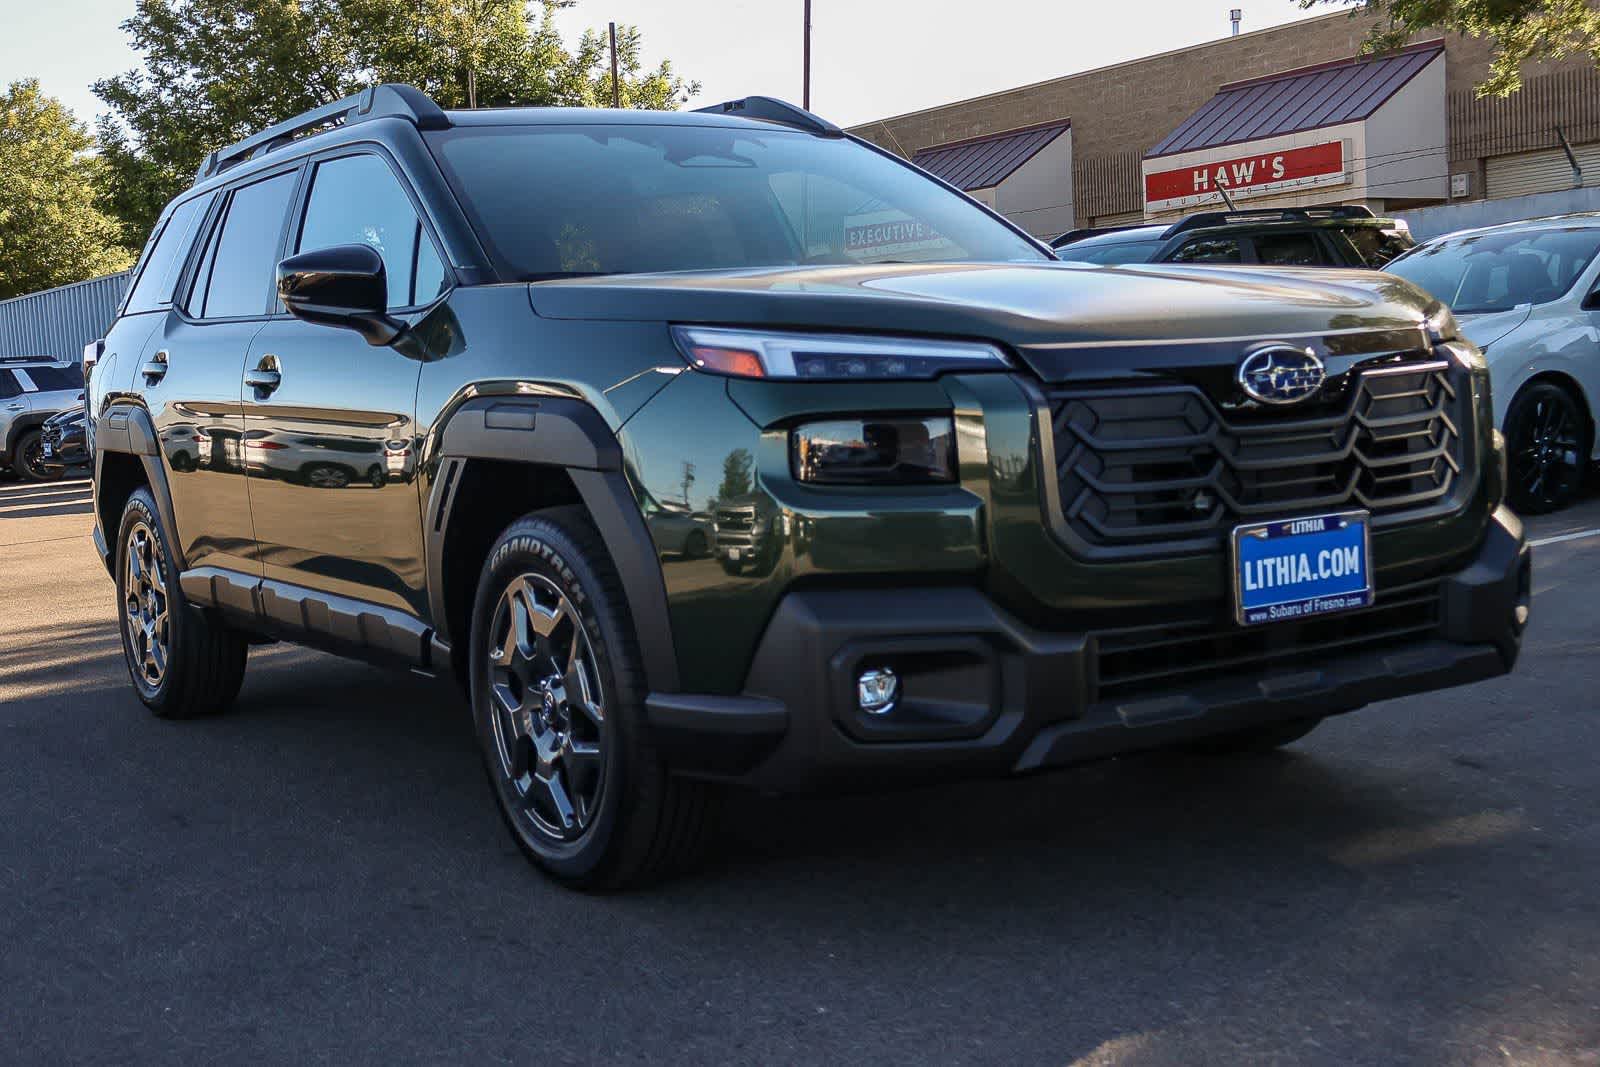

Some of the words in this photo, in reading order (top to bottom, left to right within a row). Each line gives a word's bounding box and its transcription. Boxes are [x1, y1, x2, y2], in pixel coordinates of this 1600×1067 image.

[1193, 156, 1285, 192] HAW'S
[1166, 176, 1319, 208] AUTOMOTIVE
[849, 223, 922, 246] EXECUTIVE
[1291, 518, 1325, 534] LITHIA
[1244, 545, 1359, 591] LITHIA.COM
[1269, 605, 1302, 619] Subaru
[1303, 600, 1313, 613] of
